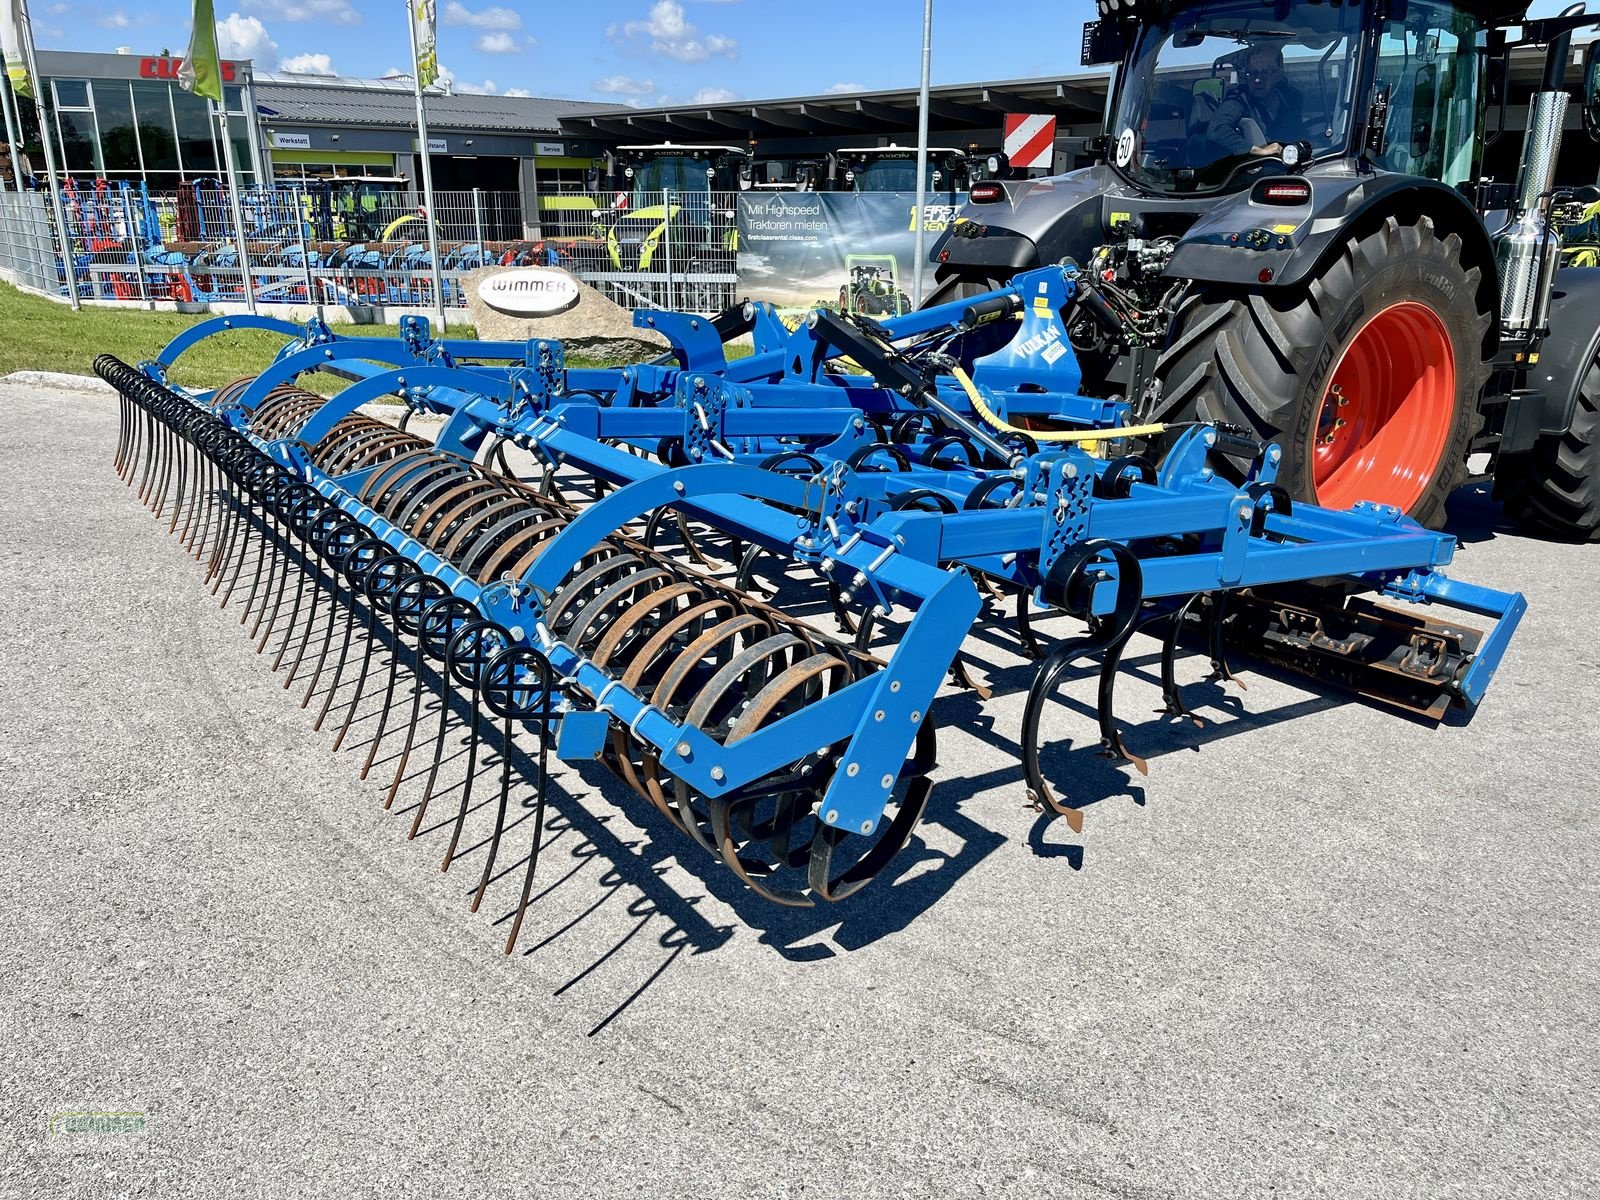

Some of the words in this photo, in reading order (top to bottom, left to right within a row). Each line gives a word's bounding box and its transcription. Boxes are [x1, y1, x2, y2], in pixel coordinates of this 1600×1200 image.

[279, 137, 308, 145] Werkstatt
[1119, 136, 1131, 159] 50
[748, 204, 764, 215] Mit
[765, 204, 820, 218] Highspeed
[747, 219, 792, 231] Traktoren
[794, 219, 830, 231] mieten.
[491, 280, 567, 293] WIMMER
[1014, 324, 1062, 359] VULKAN
[1294, 343, 1333, 466] MICHELIN
